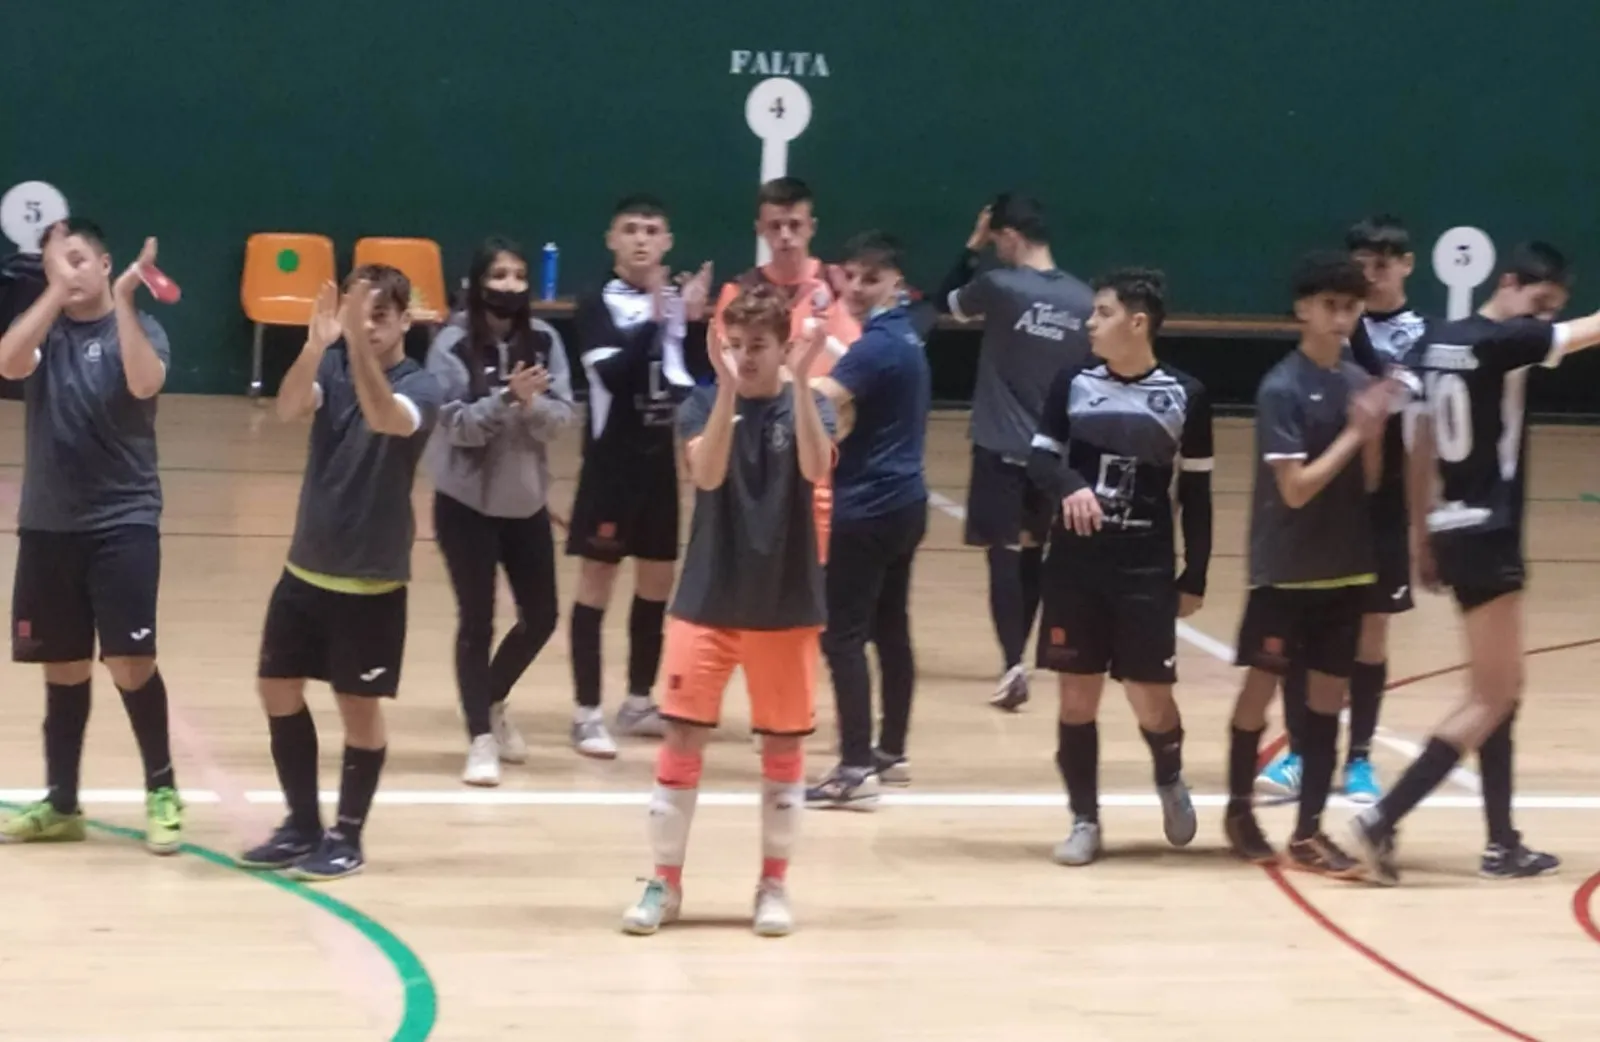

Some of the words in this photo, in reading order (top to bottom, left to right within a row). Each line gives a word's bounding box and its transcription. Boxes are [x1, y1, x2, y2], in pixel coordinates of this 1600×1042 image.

[729, 49, 830, 77] FALTA
[768, 96, 786, 119] 4
[23, 200, 43, 223] 5
